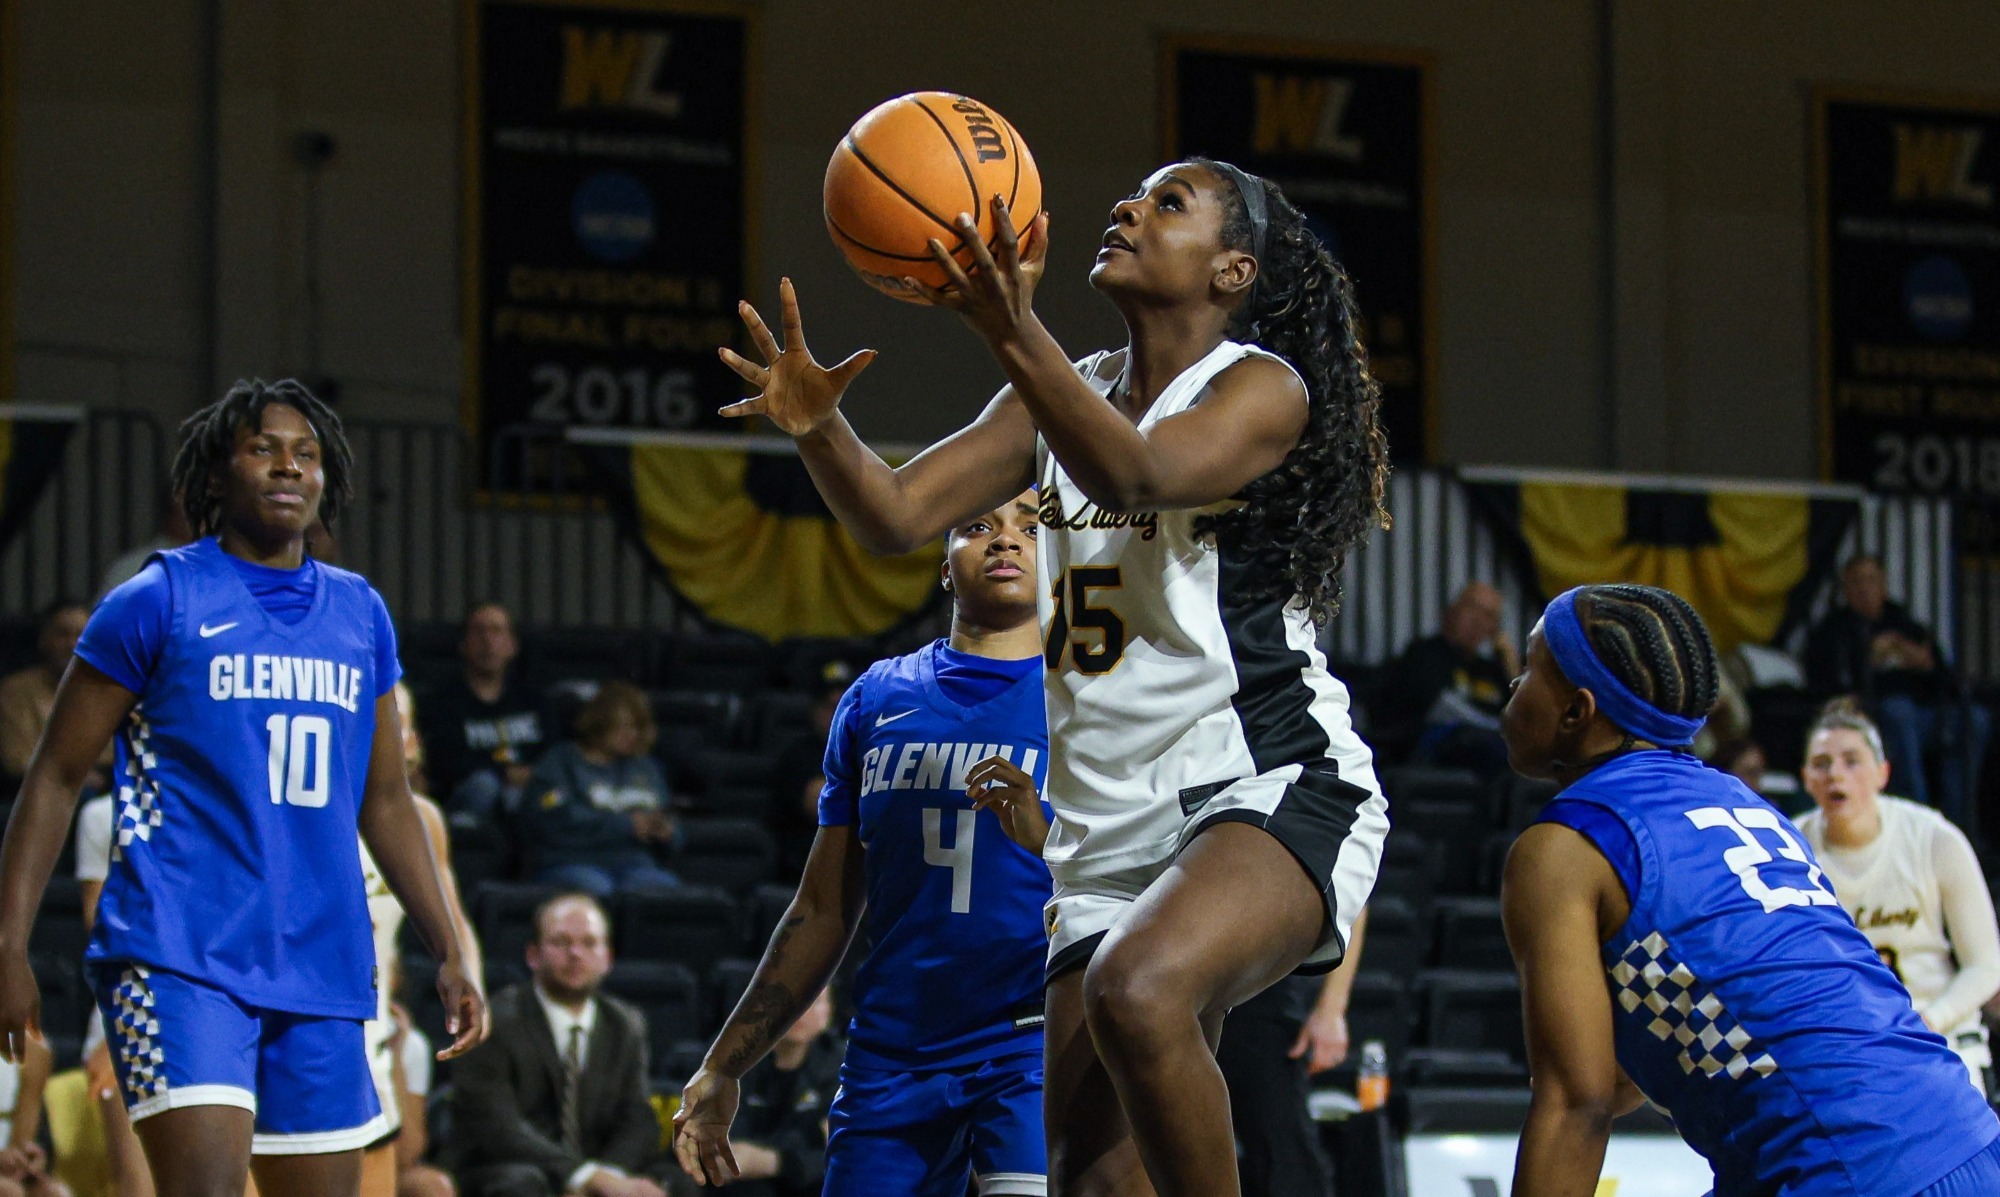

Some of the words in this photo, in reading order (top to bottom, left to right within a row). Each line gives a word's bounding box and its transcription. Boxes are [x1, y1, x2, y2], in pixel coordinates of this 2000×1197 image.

[559, 24, 684, 117] WL
[1253, 71, 1363, 164] WL
[1894, 121, 1994, 207] WL
[528, 361, 699, 427] 2016
[1045, 564, 1125, 677] 15
[208, 653, 363, 714] GLENVILLE
[265, 712, 332, 809] 10
[921, 807, 977, 914] 4
